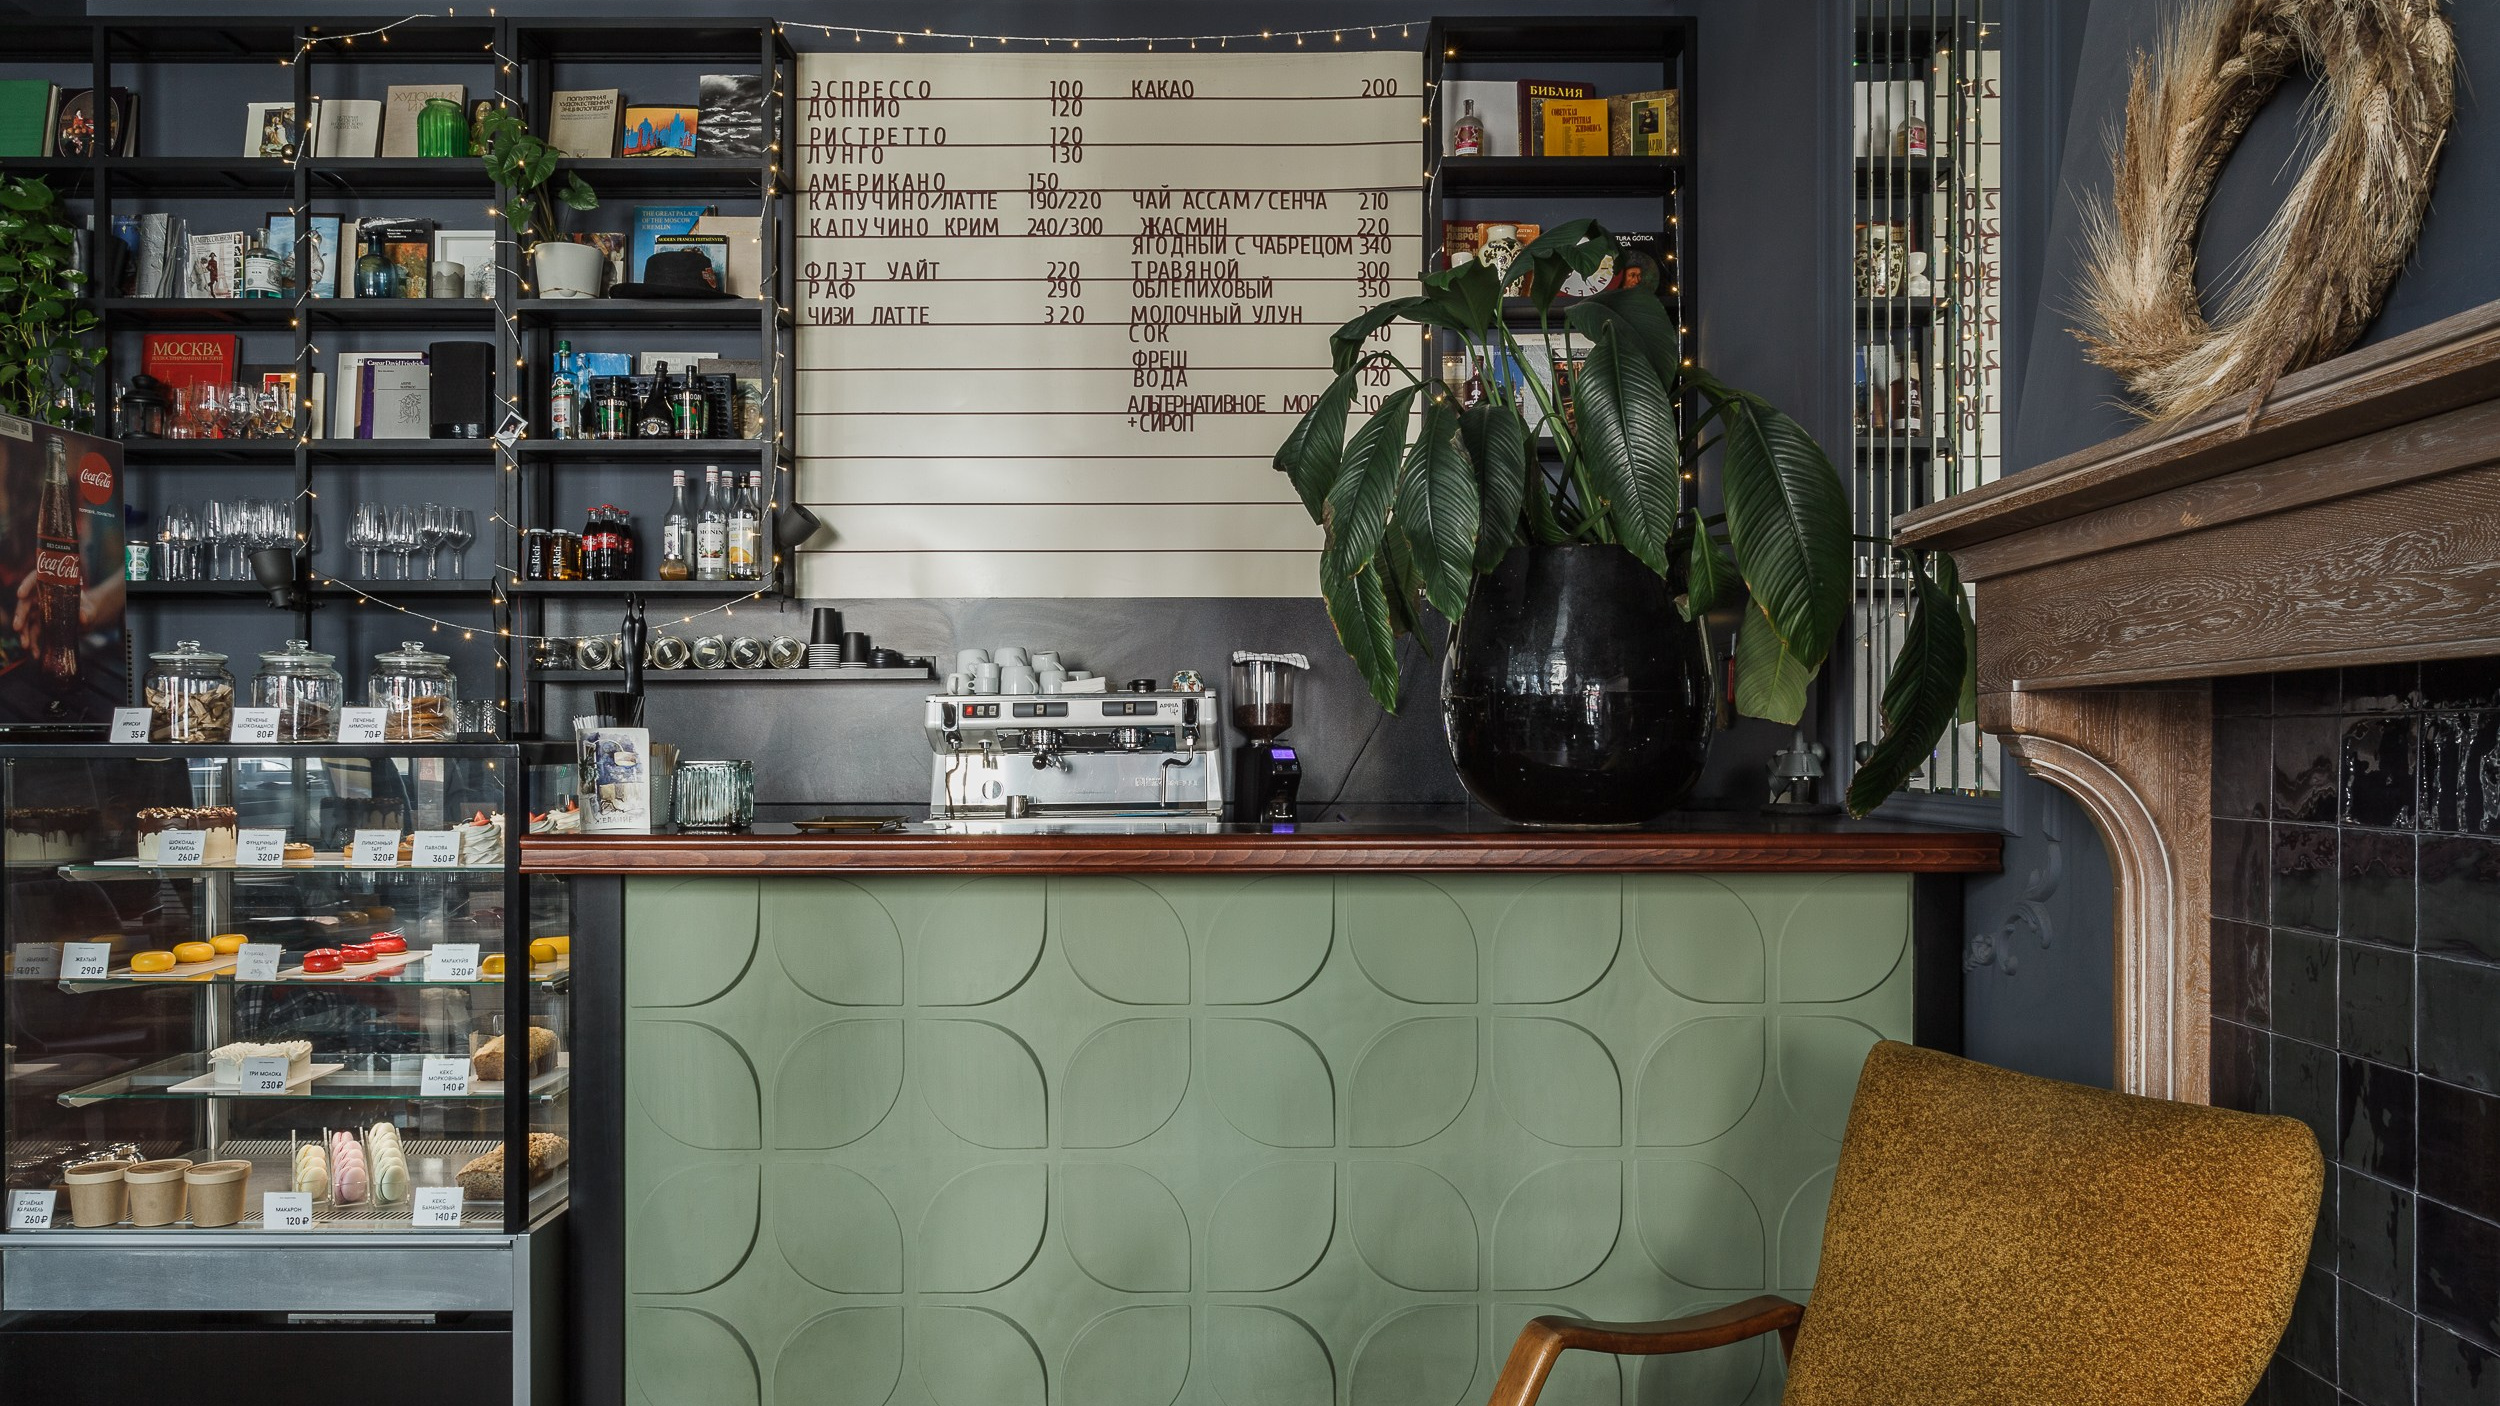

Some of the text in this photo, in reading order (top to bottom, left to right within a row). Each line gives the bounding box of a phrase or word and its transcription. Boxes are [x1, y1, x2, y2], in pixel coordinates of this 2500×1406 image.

[810, 80, 1083, 99] ЭСПРЕССО 100
[1131, 78, 1397, 98] КАКАО 200
[1530, 85, 1583, 98] БИБЛИЯ
[559, 99, 614, 107] ХУДОЖЕСТВЕННАЯ
[561, 105, 611, 113] ЭНЦИКЛОПЕДИЯ
[808, 99, 1083, 121] ДОППИО 120
[1551, 108, 1578, 117] СОВЕТСКАЯ
[1562, 116, 1592, 125] ПОРТРЕТНАЯ
[1575, 124, 1602, 133] ЖИВОПИСЬ
[810, 126, 1083, 145] РИСТРЕТТО 120
[807, 146, 1083, 164] ЛУНГО 130
[808, 172, 1059, 191] АМЕРИКАНО 150
[809, 191, 1102, 211] КАПУЧИНО/ЛАТТЕ 190/220
[1132, 184, 1389, 210] ЧАЙ АССАМ/СЕНЧА 210
[810, 217, 1103, 236] КАПУЧИНО КРИМ 240/300
[1140, 216, 1389, 236] ЖАСМИН 220
[1446, 232, 1479, 241] ЛАВРОВ
[1235, 236, 1246, 255] С
[1252, 236, 1353, 258] ЧАБРЕЦОМ
[1359, 236, 1392, 255] 340
[804, 258, 1080, 280] ФЛЭТ УАЙТ 220
[1131, 258, 1390, 280] ТРАВЯНОЙ 300
[808, 281, 1081, 300] РАФ 290
[1132, 276, 1391, 298] ОБЛЕПИХОВЫЙ 350
[808, 305, 1085, 325] ЧИЗИ ЛАТТЕ 320
[1131, 302, 1303, 324] МОЛОЧНЫЙ УЛУН
[1128, 324, 1169, 343] СОК
[153, 342, 223, 356] МОСКВА
[1132, 349, 1187, 369] ФРЕШ
[1133, 369, 1391, 390] ВОДА 120
[1127, 394, 1266, 413] АЛЬТЕРНАТИВНОЕ
[1127, 413, 1194, 432] +СИРОП
[532, 545, 541, 564] Rich
[553, 546, 561, 565] Rich
